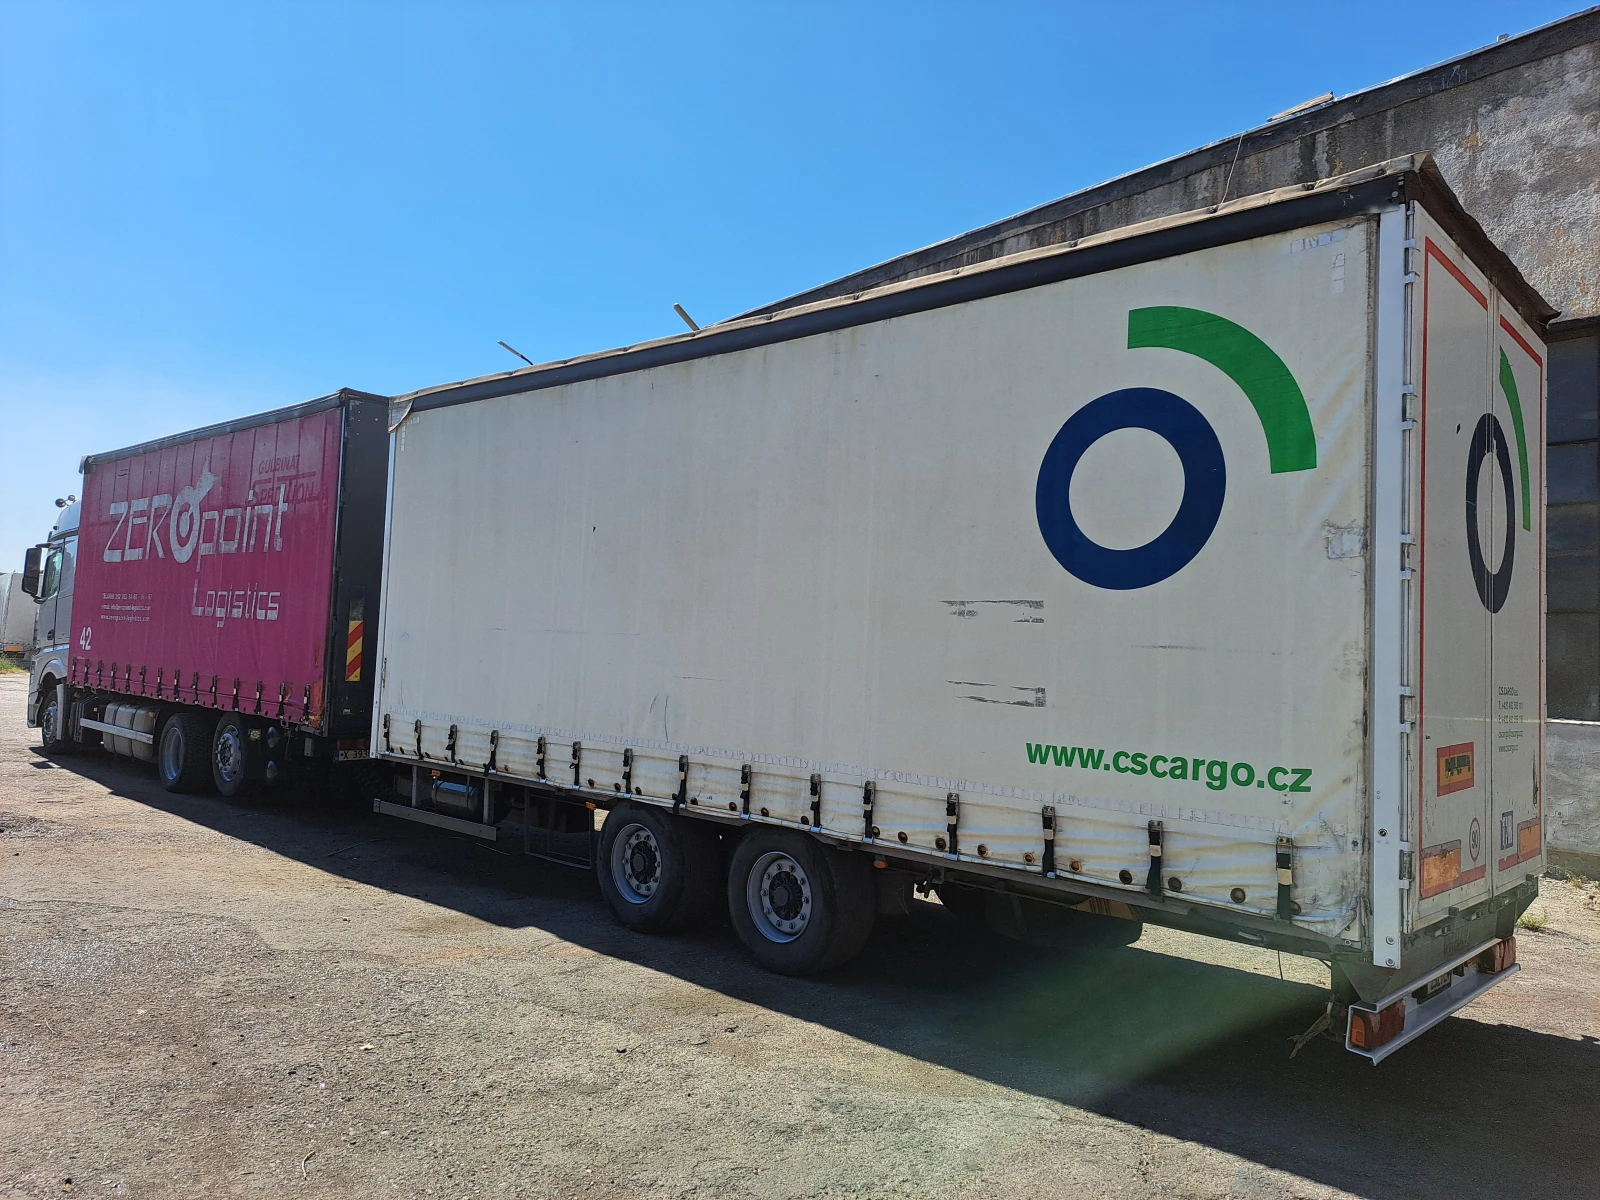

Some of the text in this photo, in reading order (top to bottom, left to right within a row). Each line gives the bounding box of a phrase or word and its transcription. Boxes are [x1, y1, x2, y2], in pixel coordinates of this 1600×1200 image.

[191, 579, 281, 628] Logistics
[79, 626, 92, 651] 42
[1025, 742, 1313, 793] www.cscargo.cz
[1471, 829, 1479, 849] 90
